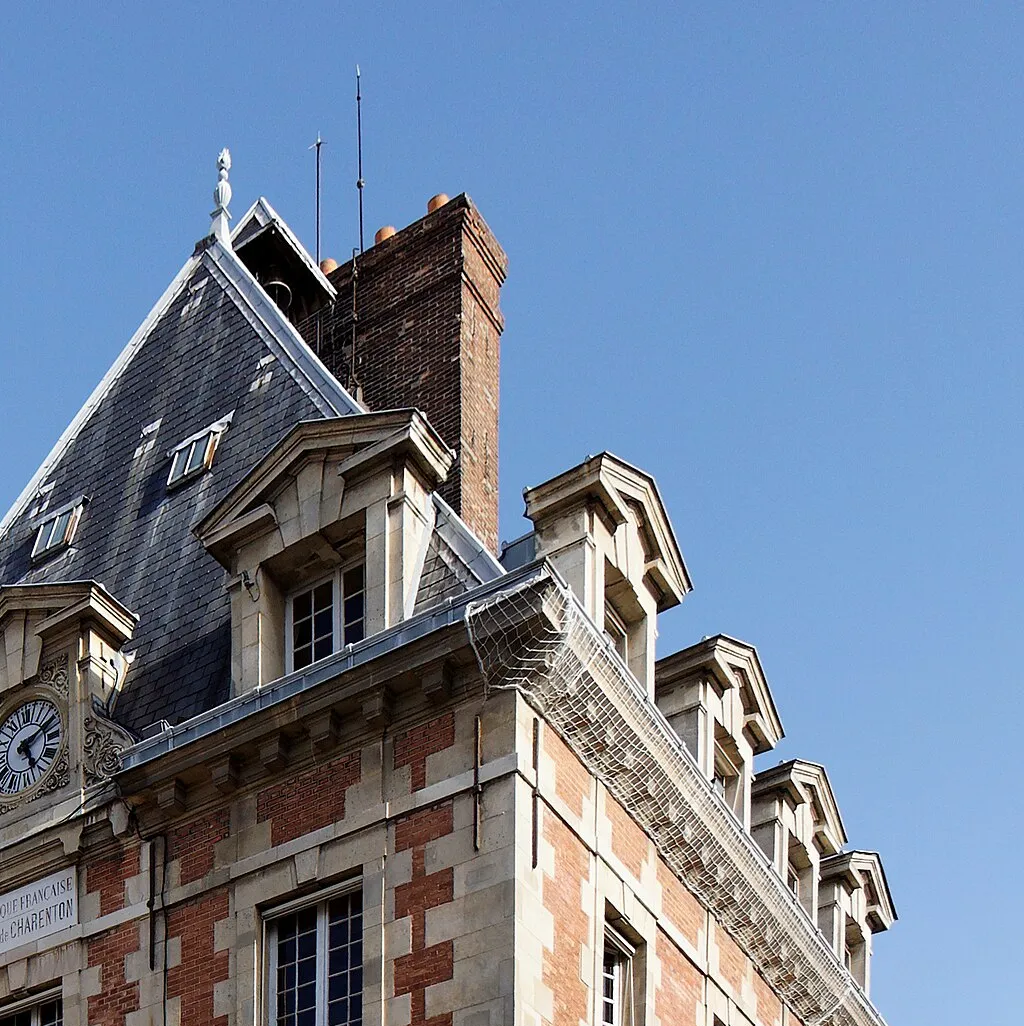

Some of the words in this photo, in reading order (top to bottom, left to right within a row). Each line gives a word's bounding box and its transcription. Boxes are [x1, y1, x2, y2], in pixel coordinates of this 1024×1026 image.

[20, 876, 73, 910] FRANÇAISE
[0, 928, 9, 944] de
[10, 898, 74, 939] CHARENTON
